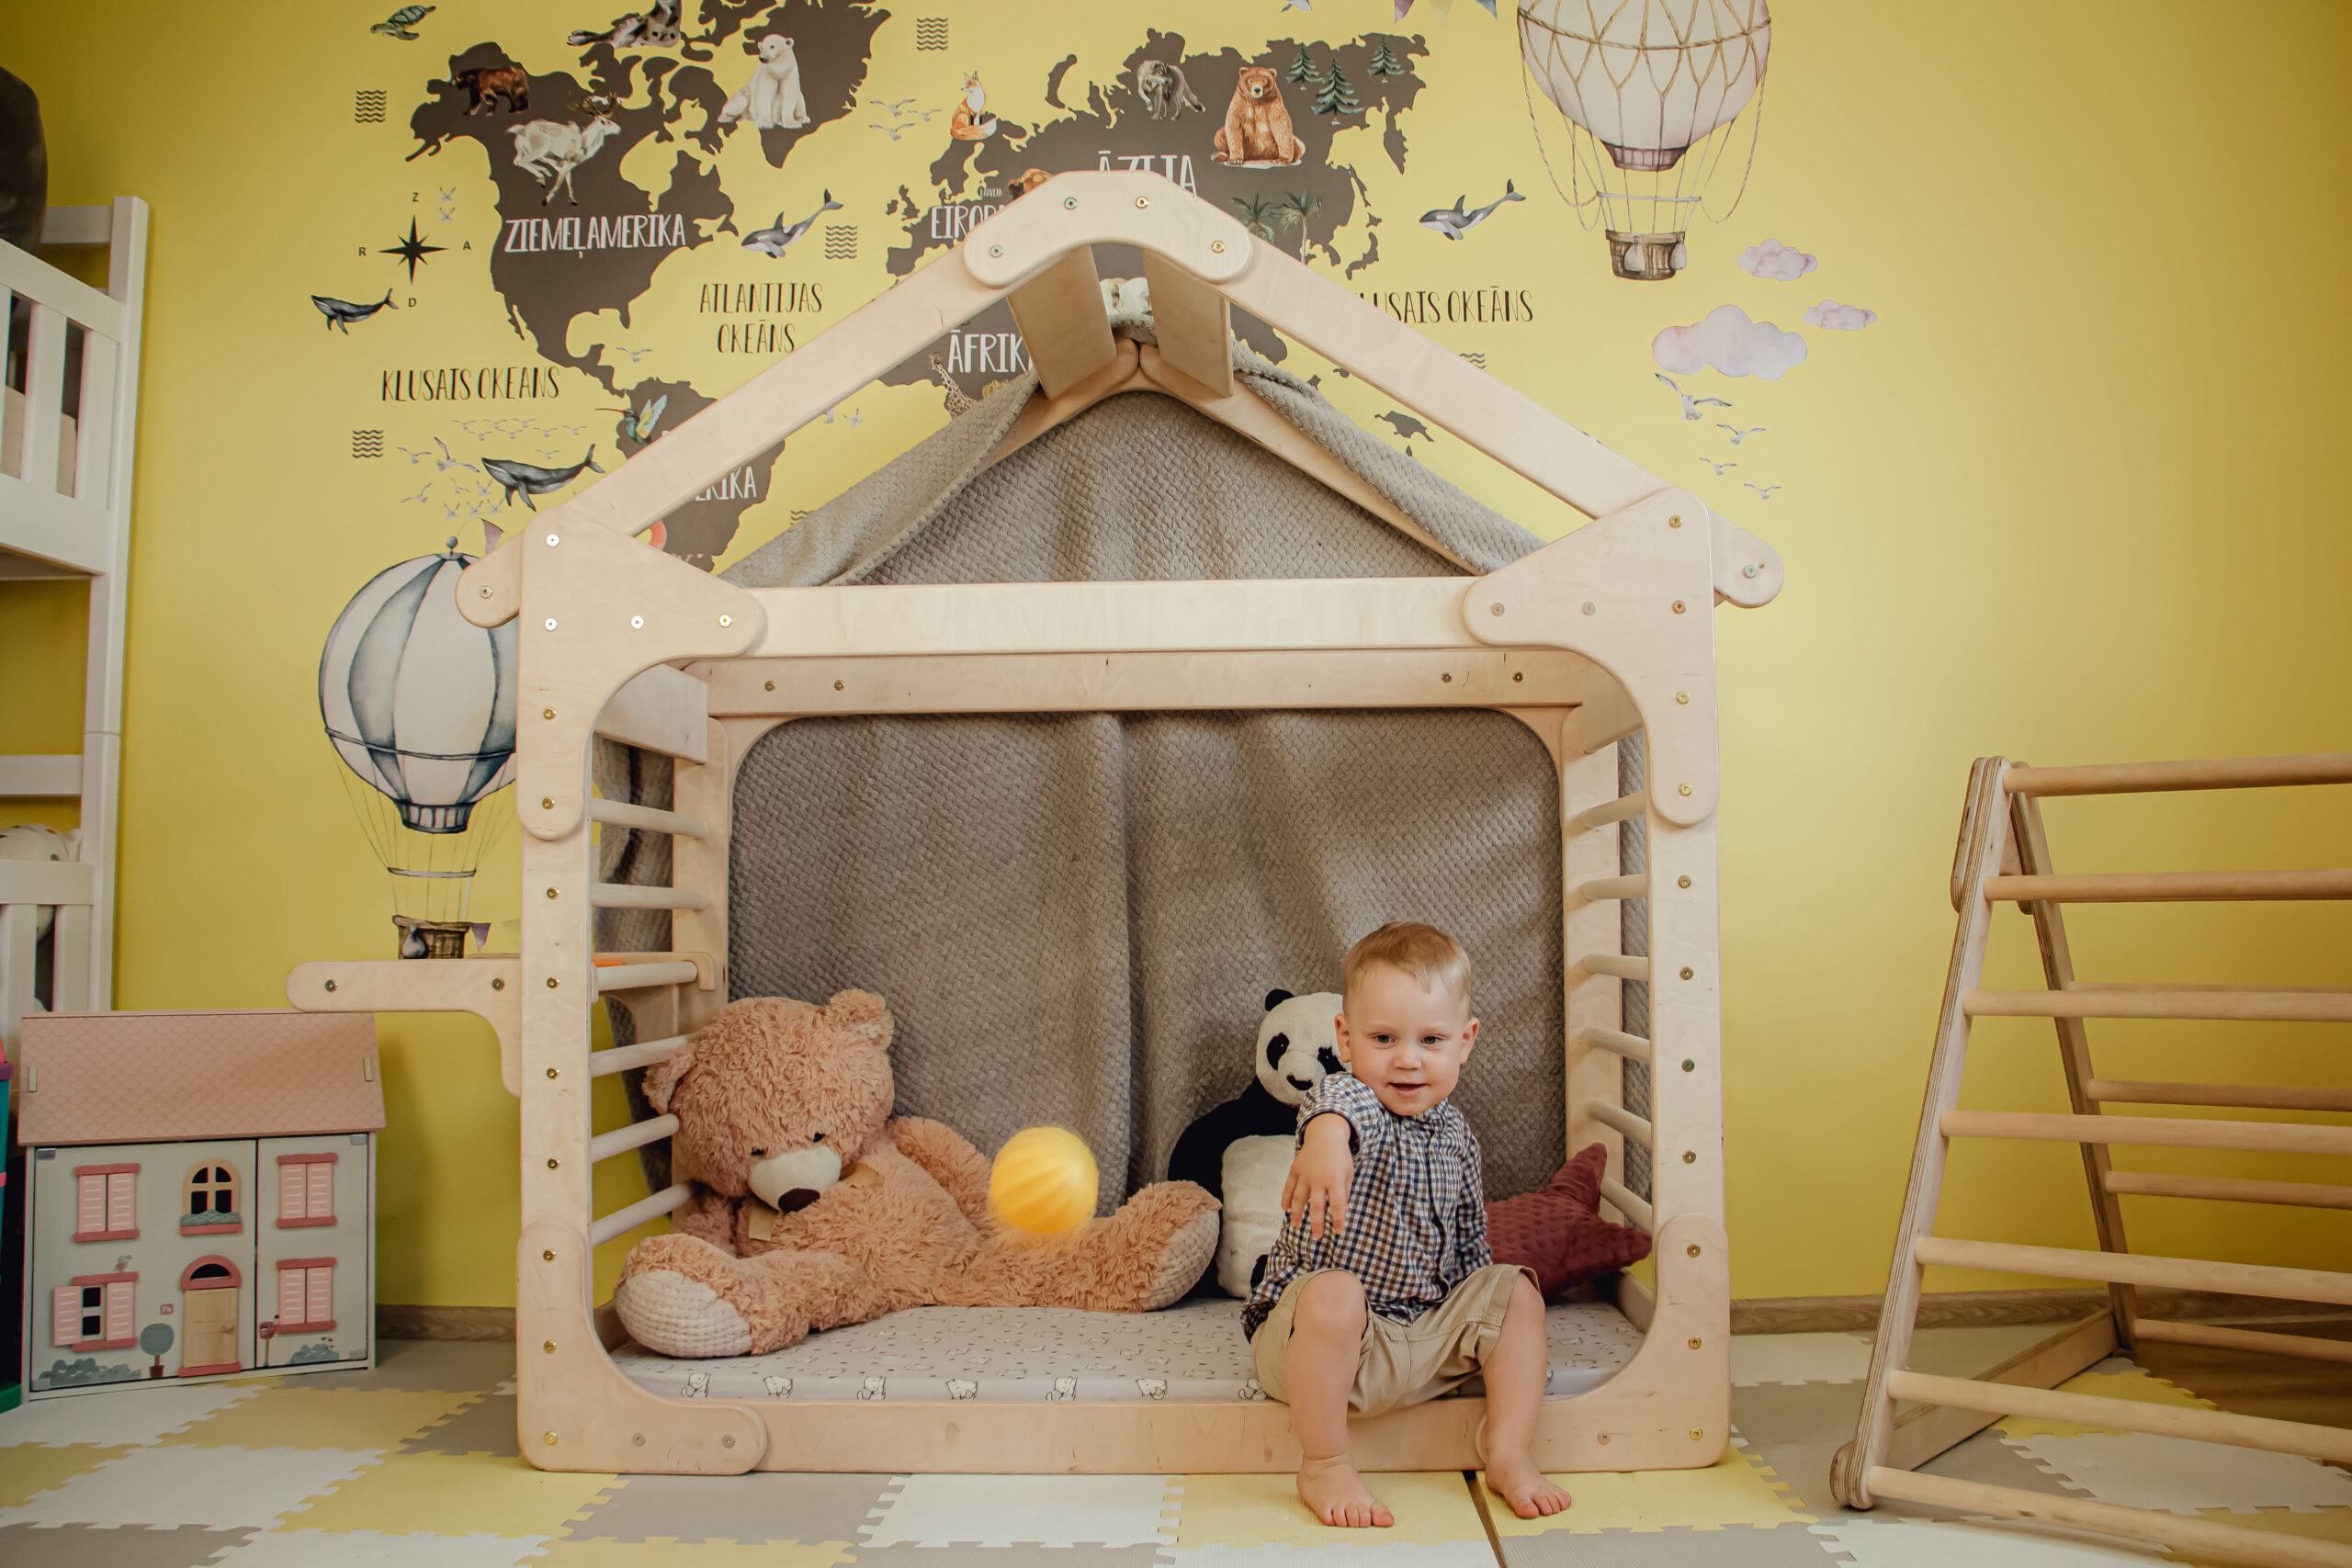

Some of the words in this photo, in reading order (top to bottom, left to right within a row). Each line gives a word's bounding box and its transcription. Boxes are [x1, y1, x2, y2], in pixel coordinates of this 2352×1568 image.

[412, 192, 419, 202] Z
[358, 246, 367, 256] R
[462, 241, 471, 251] A
[504, 213, 686, 259] ZIEMEĻAMERIKA
[408, 298, 417, 308] D
[699, 282, 823, 313] ATLANTIJAS
[1447, 286, 1533, 322] OKEĀNS
[717, 319, 796, 354] OKEĀNS
[947, 330, 1034, 373] ĀFRIK
[381, 368, 471, 401] KLUSAIS
